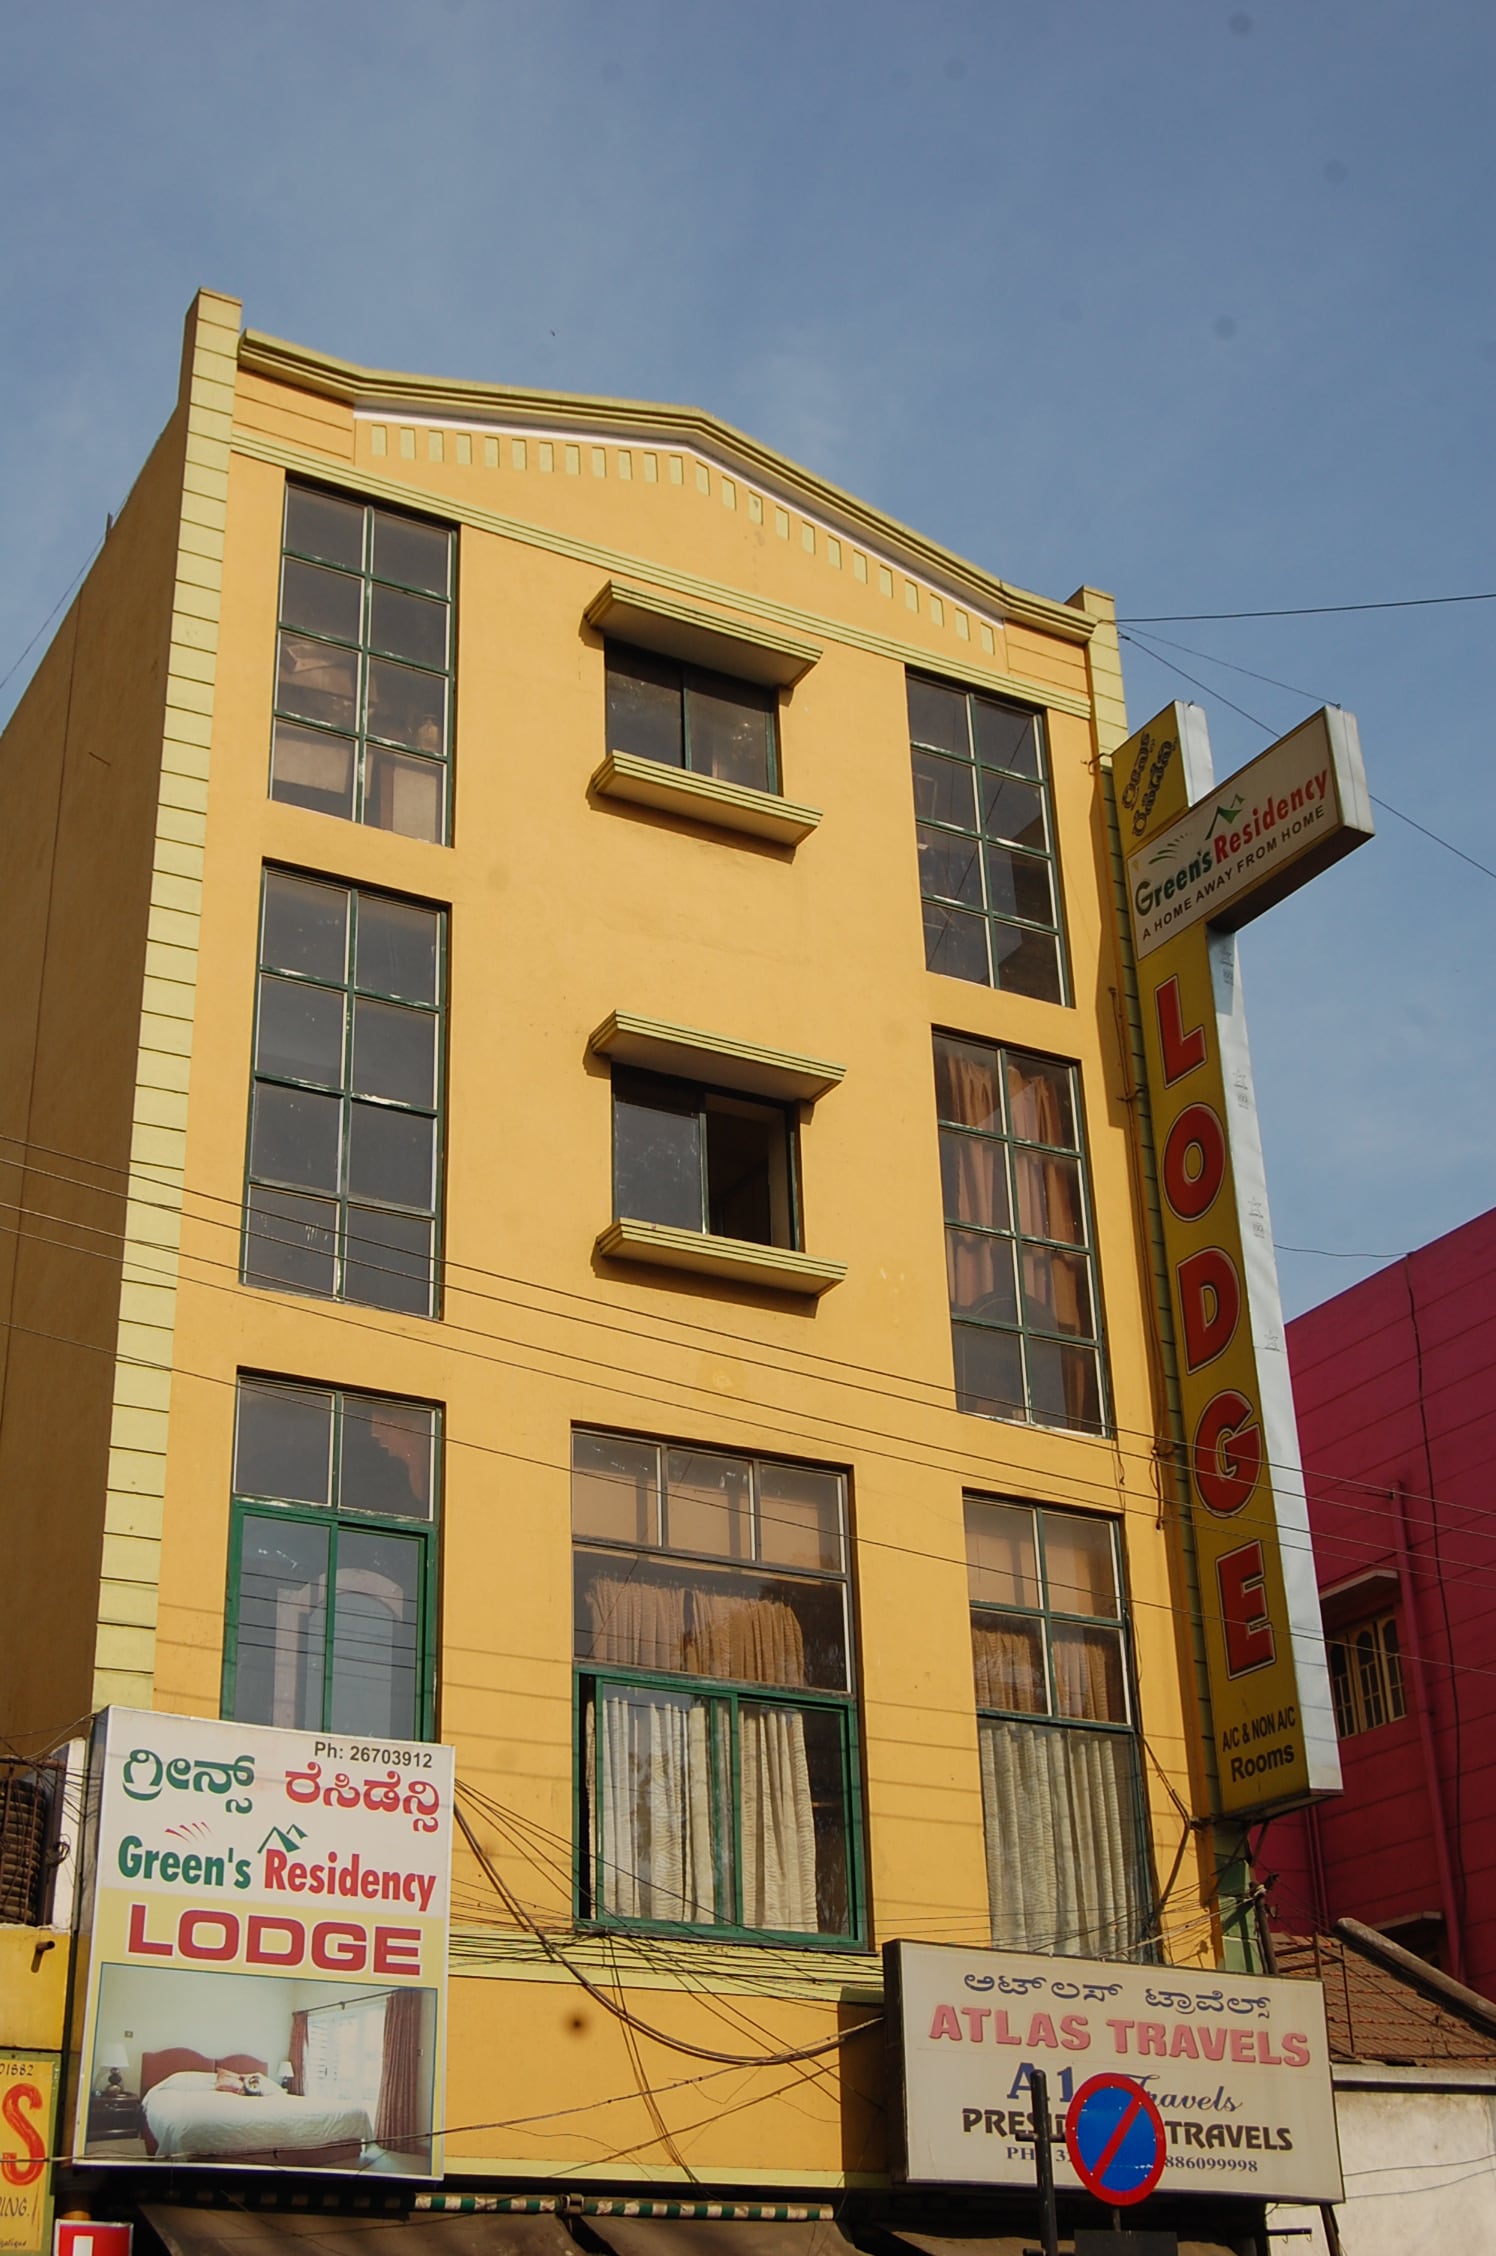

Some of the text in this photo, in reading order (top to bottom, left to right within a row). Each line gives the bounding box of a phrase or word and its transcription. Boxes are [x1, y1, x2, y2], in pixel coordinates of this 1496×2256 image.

[1134, 768, 1328, 917] Green's Residency
[1142, 804, 1325, 941] A HOME AWAY FROM HOME
[1155, 973, 1276, 1680] LODGE
[314, 1741, 433, 1769] Ph: 26703912
[1222, 1706, 1296, 1752] A/C & NON A/C
[1230, 1744, 1294, 1783] Rooms
[118, 1835, 436, 1912] Green's Residency
[128, 1903, 422, 1977] LODGE
[929, 2004, 1311, 2067] ATLAS TRAVELS
[1165, 2120, 1293, 2151] TRAVELS
